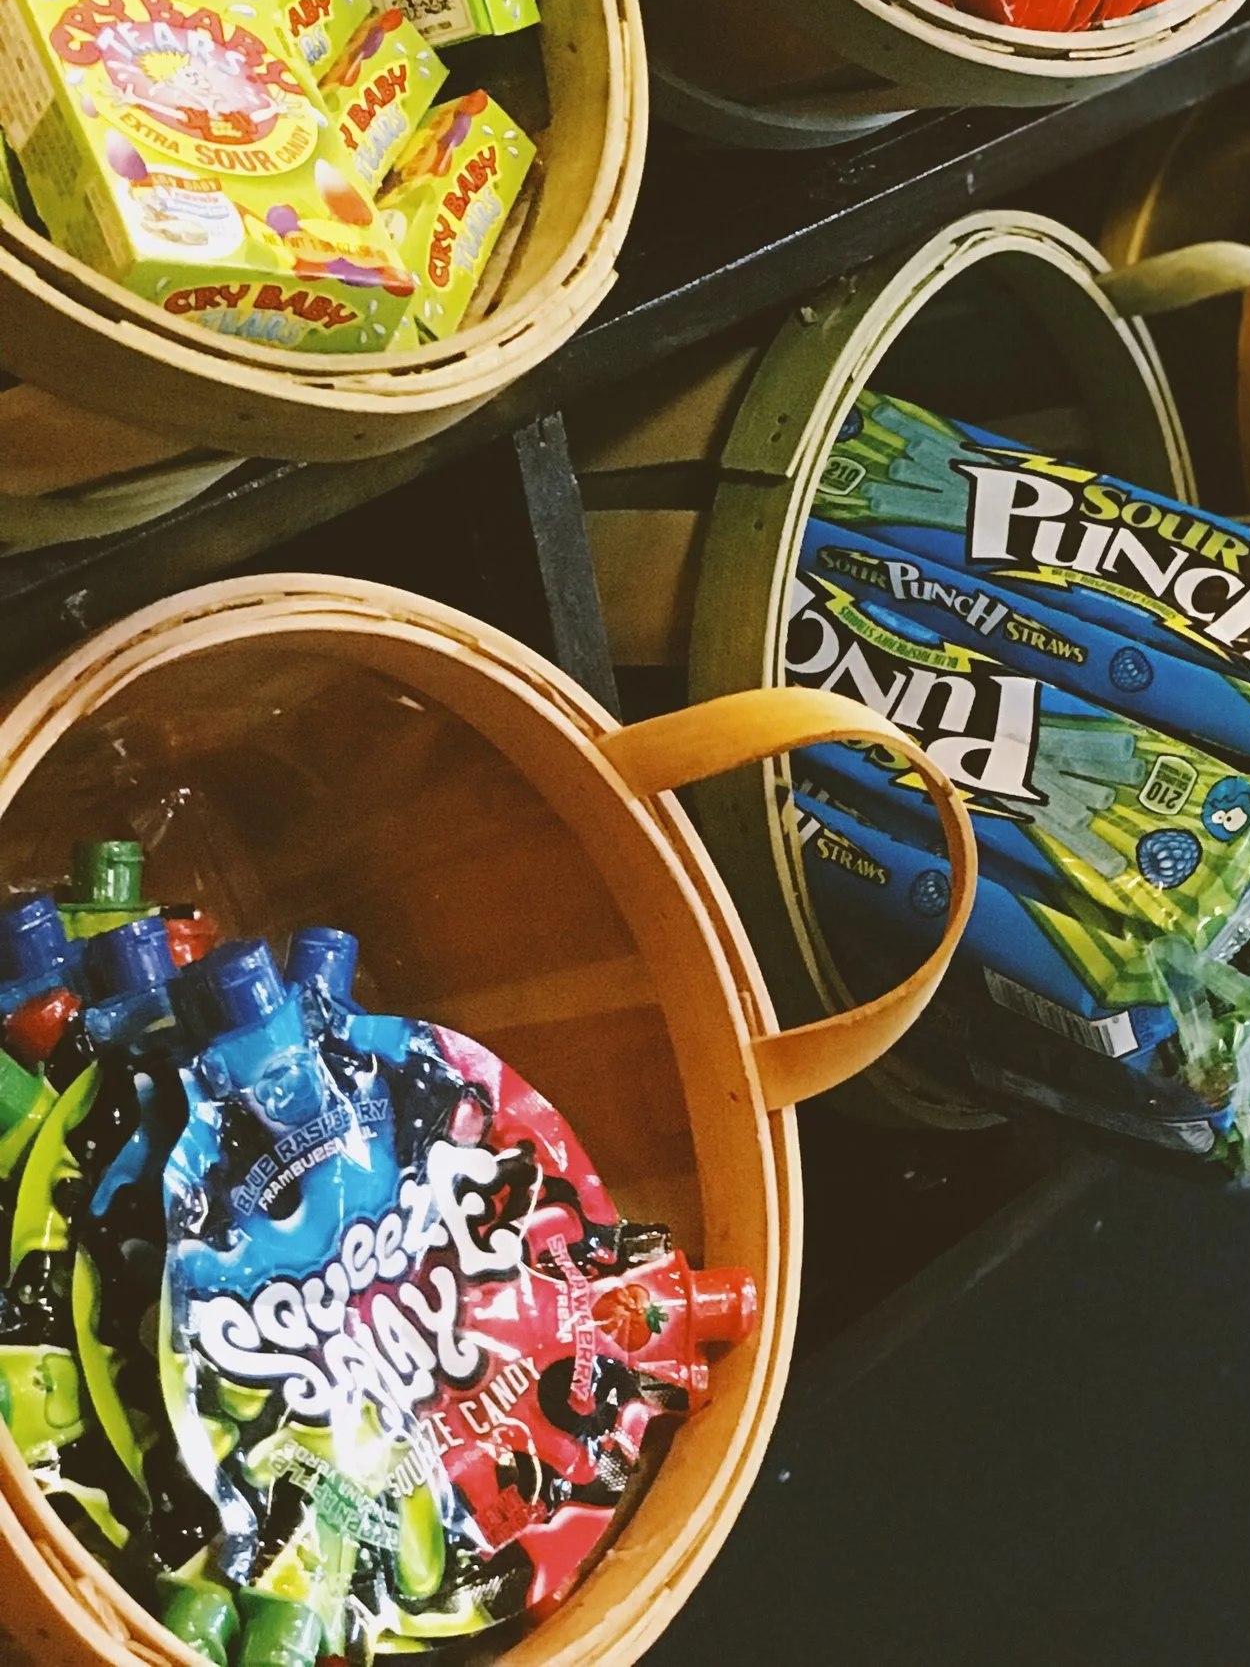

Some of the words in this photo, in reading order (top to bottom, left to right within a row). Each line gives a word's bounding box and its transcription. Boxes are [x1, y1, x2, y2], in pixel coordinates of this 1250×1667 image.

[97, 21, 248, 77] TEARS
[347, 64, 408, 133] BABY
[119, 111, 181, 154] EXTRA
[195, 143, 279, 173] SOUR
[275, 123, 313, 165] CANDY
[442, 145, 498, 221] BABY
[428, 213, 457, 289] CRY
[163, 284, 252, 315] CRY
[253, 284, 358, 329] BABY
[826, 460, 861, 483] 210
[1080, 484, 1249, 573] SOUR
[818, 549, 888, 589] SOUR
[884, 561, 1010, 636] PUNCH
[1005, 620, 1085, 665] STRAWS
[1146, 781, 1183, 809] 210
[815, 837, 887, 884] STRAWS
[233, 1153, 280, 1216] BLUE
[459, 1356, 541, 1436] CANDY
